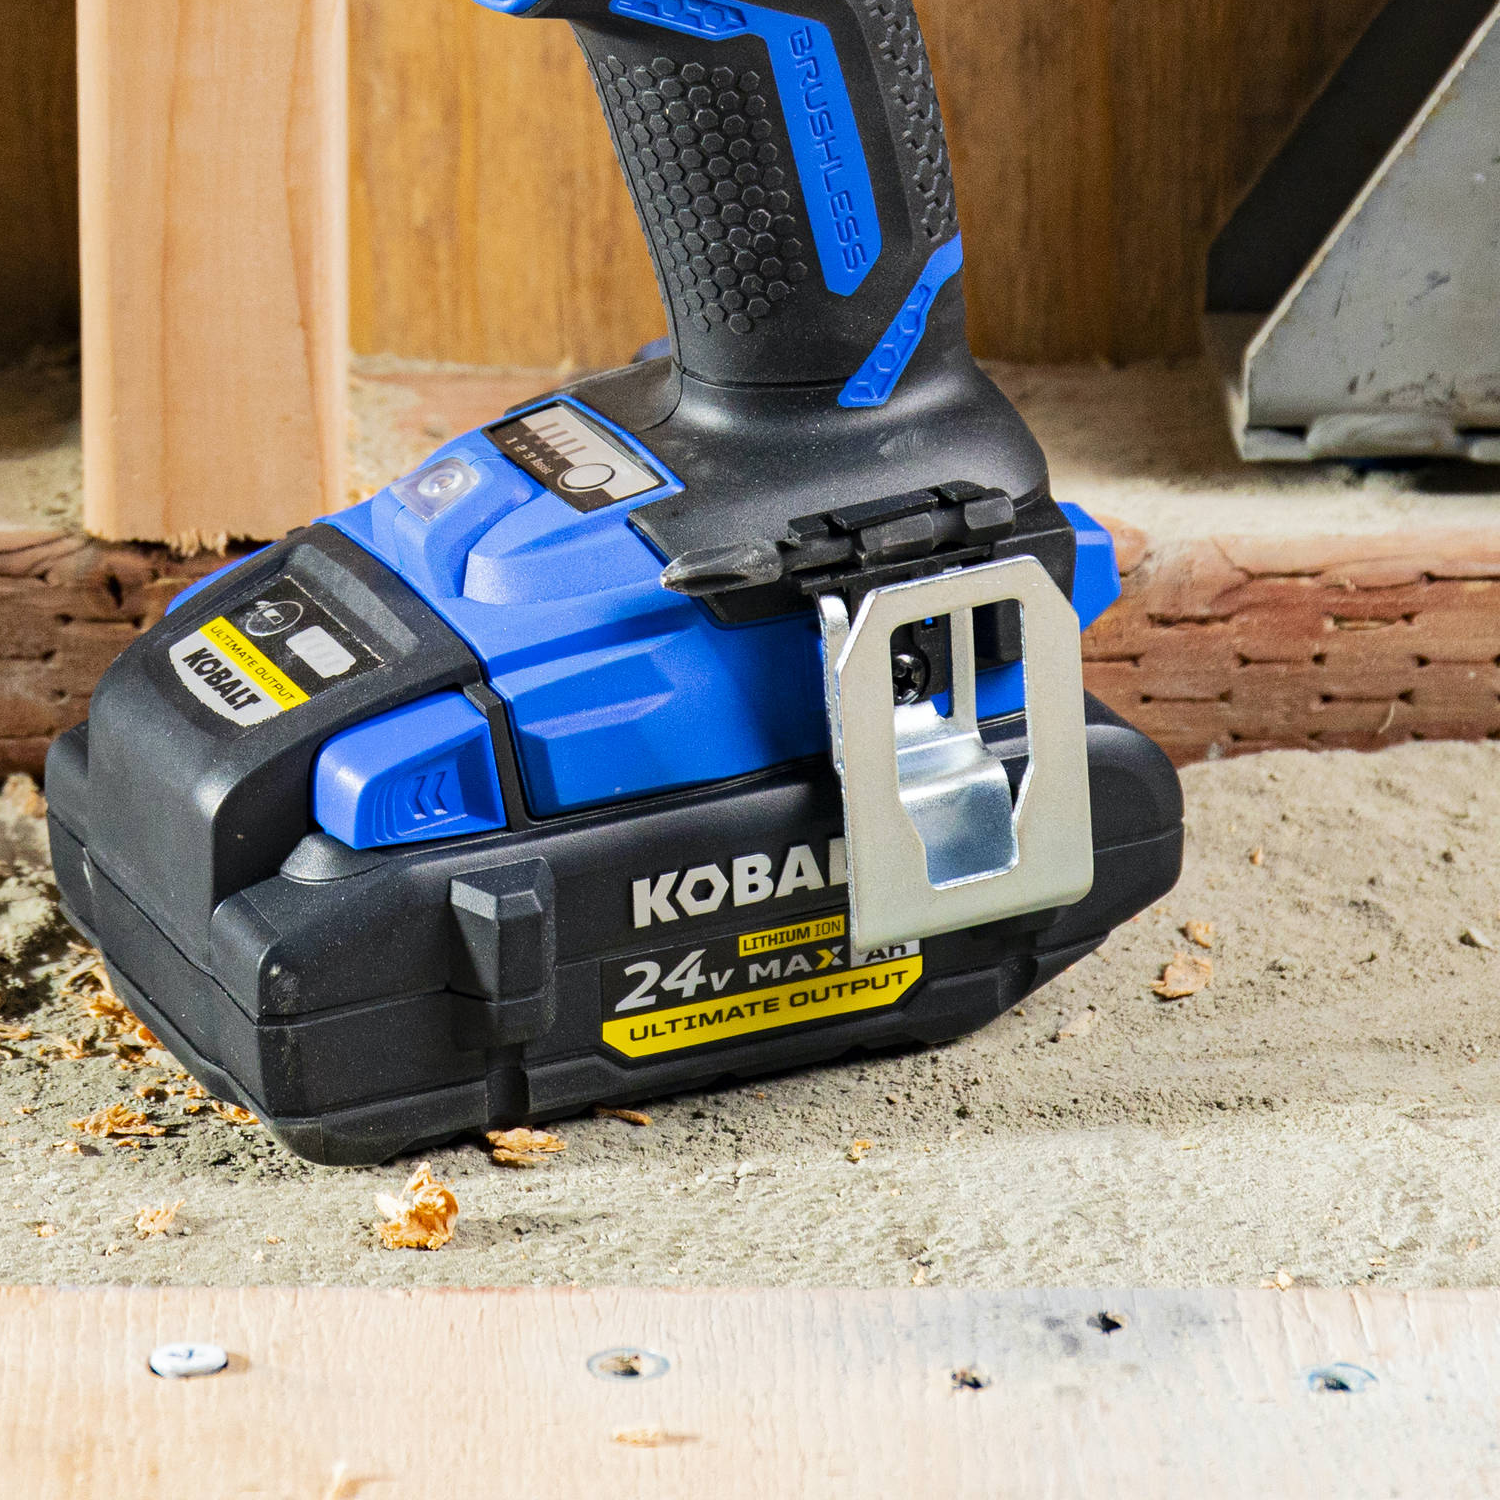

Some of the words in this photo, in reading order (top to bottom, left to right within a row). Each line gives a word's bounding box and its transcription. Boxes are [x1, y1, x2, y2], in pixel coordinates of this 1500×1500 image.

[787, 26, 867, 273] BRUSHLESS
[523, 451, 537, 460] 3
[182, 646, 262, 711] KOBALT
[210, 625, 259, 668] ULTIMATE
[255, 666, 296, 701] OUTPUT
[632, 836, 848, 929] KOBAL
[743, 926, 811, 952] LITHIUM
[814, 920, 841, 937] ION
[749, 945, 844, 984] MAX
[630, 997, 780, 1042] ULTIMATE
[789, 970, 909, 1008] OUTPUT
